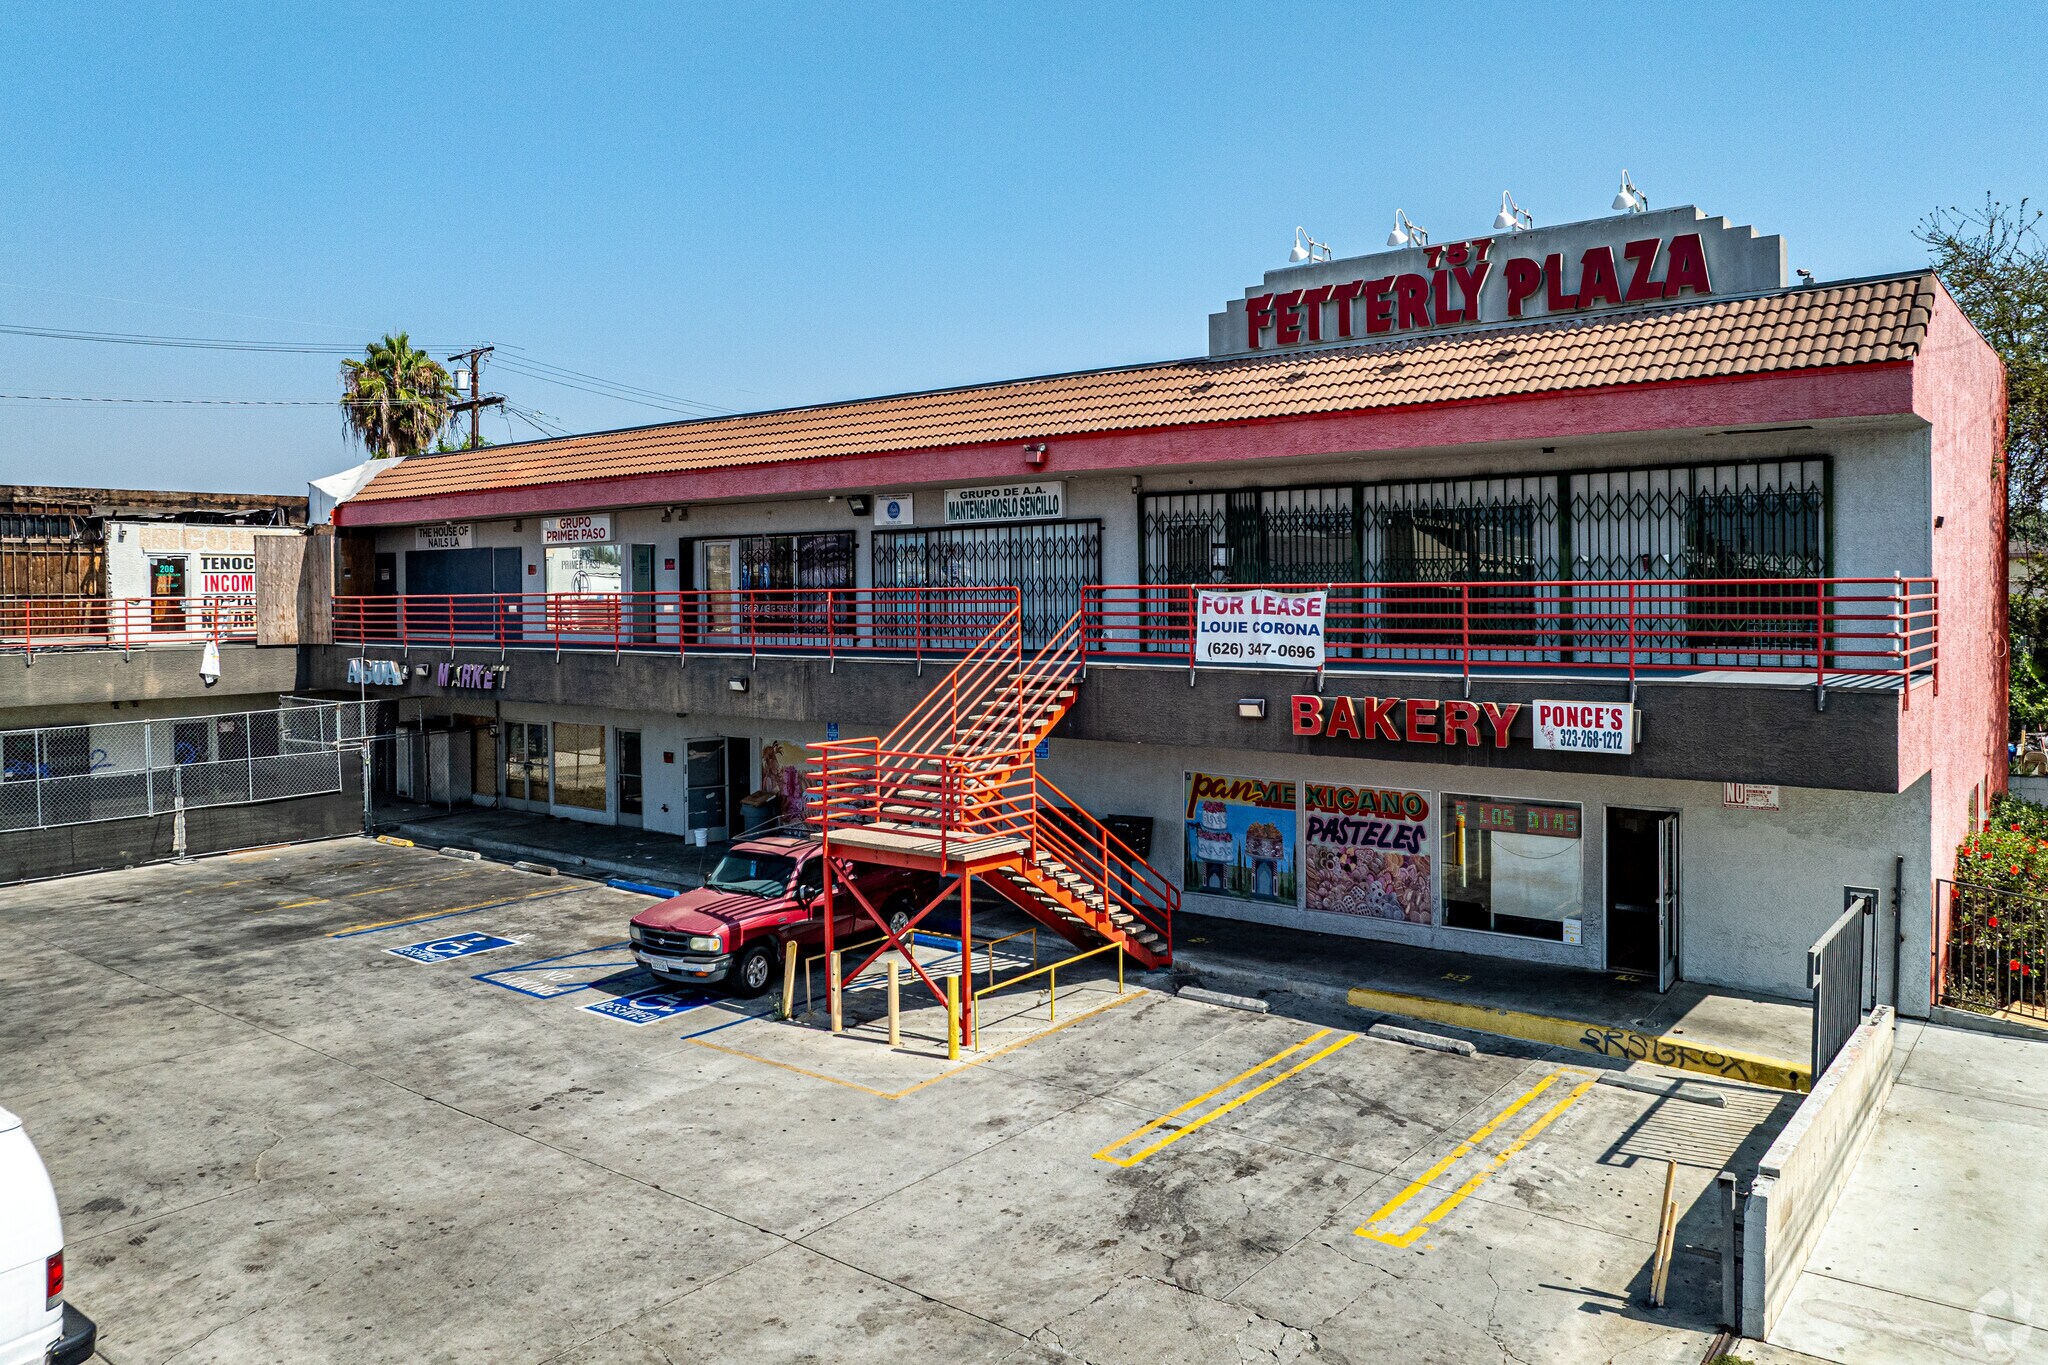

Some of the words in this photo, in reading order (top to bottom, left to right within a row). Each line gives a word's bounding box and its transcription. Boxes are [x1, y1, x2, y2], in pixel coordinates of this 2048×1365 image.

[1424, 238, 1495, 268] 757
[1245, 263, 1492, 349] FETTERLY
[1504, 233, 1713, 318] PLAZA
[959, 488, 1000, 499] GRUPO
[1003, 487, 1019, 496] DE
[1023, 486, 1047, 495] A.A.
[948, 497, 1018, 521] MANTENGAMOSLO
[1020, 494, 1059, 517] SENCILLO
[419, 527, 433, 538] THE
[434, 526, 457, 538] HOUSE
[458, 526, 469, 537] OF
[559, 516, 591, 529] GRUPO
[428, 538, 449, 548] NAILS
[450, 538, 460, 548] LA
[546, 529, 580, 542] PRIMER
[581, 528, 606, 540] PASO
[160, 565, 174, 573] 206
[201, 557, 254, 570] TENOC
[204, 575, 253, 592] INCOM
[1202, 596, 1244, 615] FOR
[1251, 595, 1321, 617] LEASE
[1201, 621, 1248, 633] LOUIE
[1252, 621, 1320, 636] CORONA
[1207, 642, 1244, 658] (626)
[1248, 643, 1315, 658] 347-0696
[1291, 694, 1523, 749] BAKERY
[1540, 705, 1624, 730] PONCE'S
[1560, 729, 1623, 750] 323-268-1212
[1186, 772, 1264, 820] pan
[1253, 779, 1426, 819] MEXICANO
[1725, 783, 1745, 803] NO
[1480, 806, 1514, 826] LOS
[1527, 811, 1577, 832] DIAS
[1306, 816, 1426, 854] PASTELES
